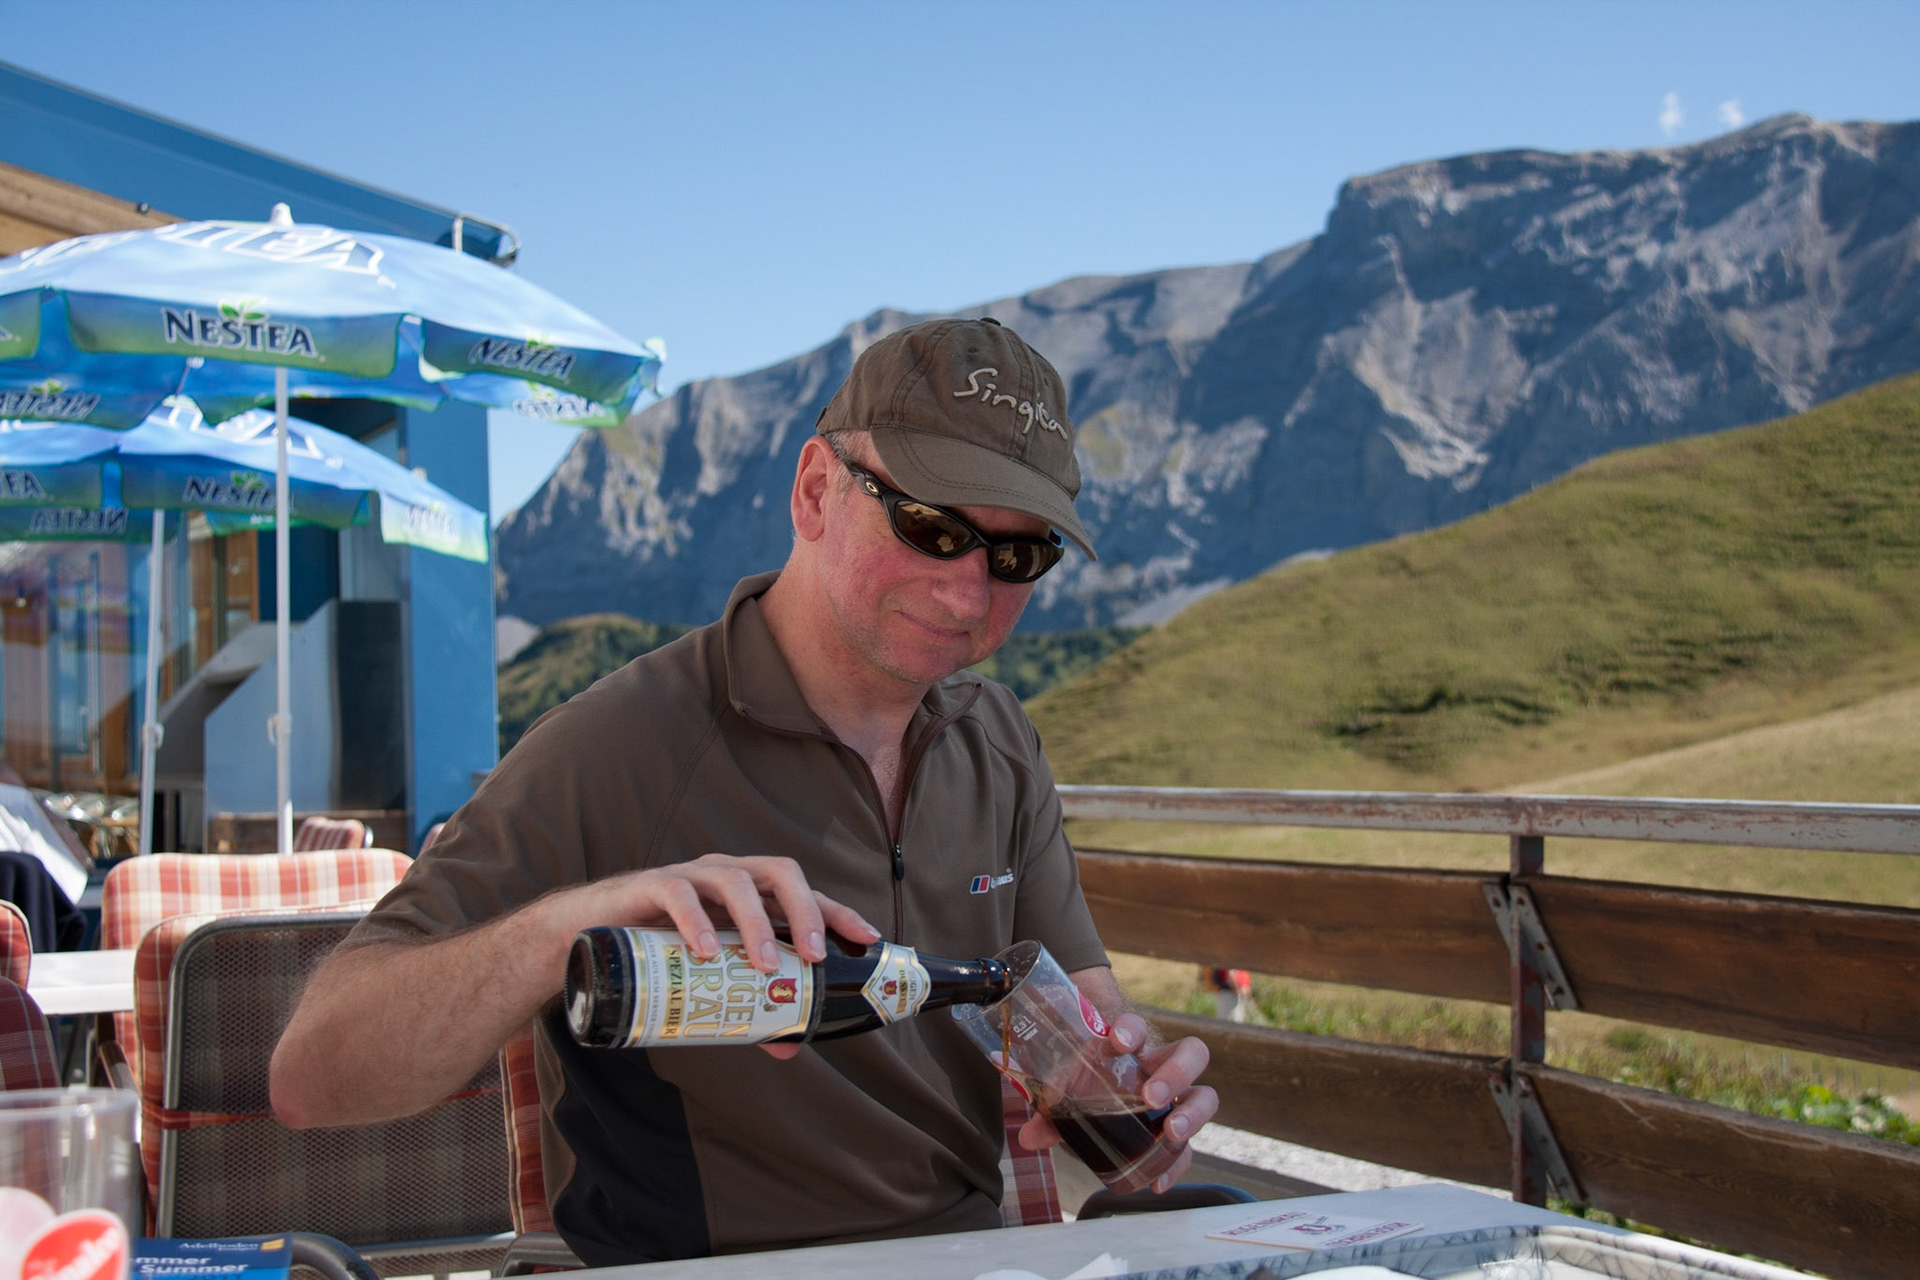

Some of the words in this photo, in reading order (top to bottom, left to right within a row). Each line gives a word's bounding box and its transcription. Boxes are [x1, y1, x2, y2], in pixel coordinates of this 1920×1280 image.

[161, 306, 318, 357] NESTEA
[468, 337, 577, 380] NESTEA
[667, 949, 683, 1004] SPEZIAL
[719, 943, 756, 1038] RUGEN
[664, 1008, 682, 1035] BIER
[131, 1256, 211, 1265] mmer
[140, 1263, 249, 1274] Summer
